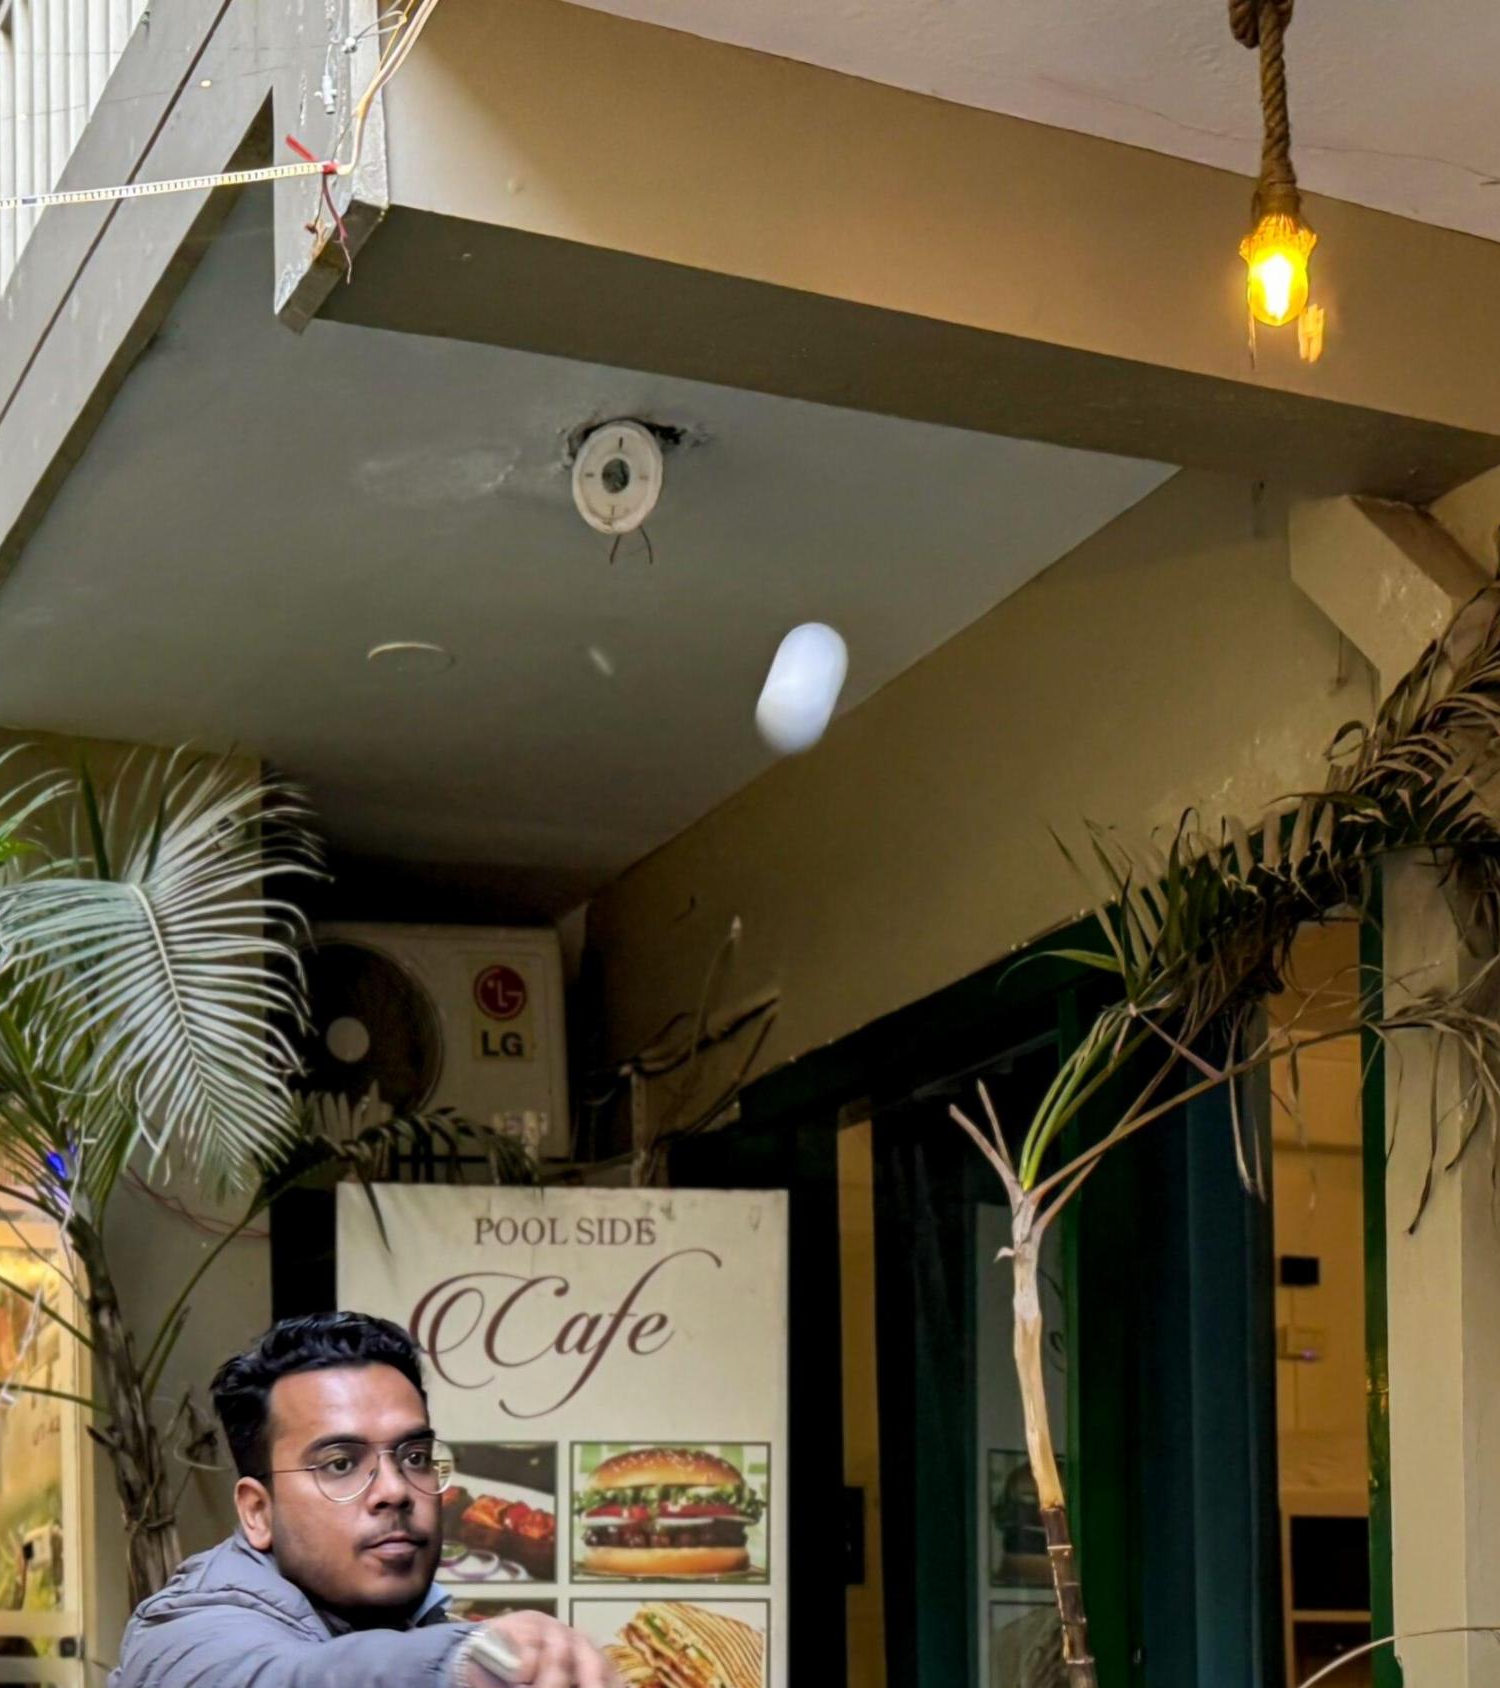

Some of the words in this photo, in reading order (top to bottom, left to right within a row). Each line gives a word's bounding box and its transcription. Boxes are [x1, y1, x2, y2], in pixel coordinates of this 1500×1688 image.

[481, 1030, 524, 1057] LG
[474, 1216, 568, 1246] POOL
[575, 1216, 657, 1246] SIDE
[409, 1248, 723, 1419] Cafe
